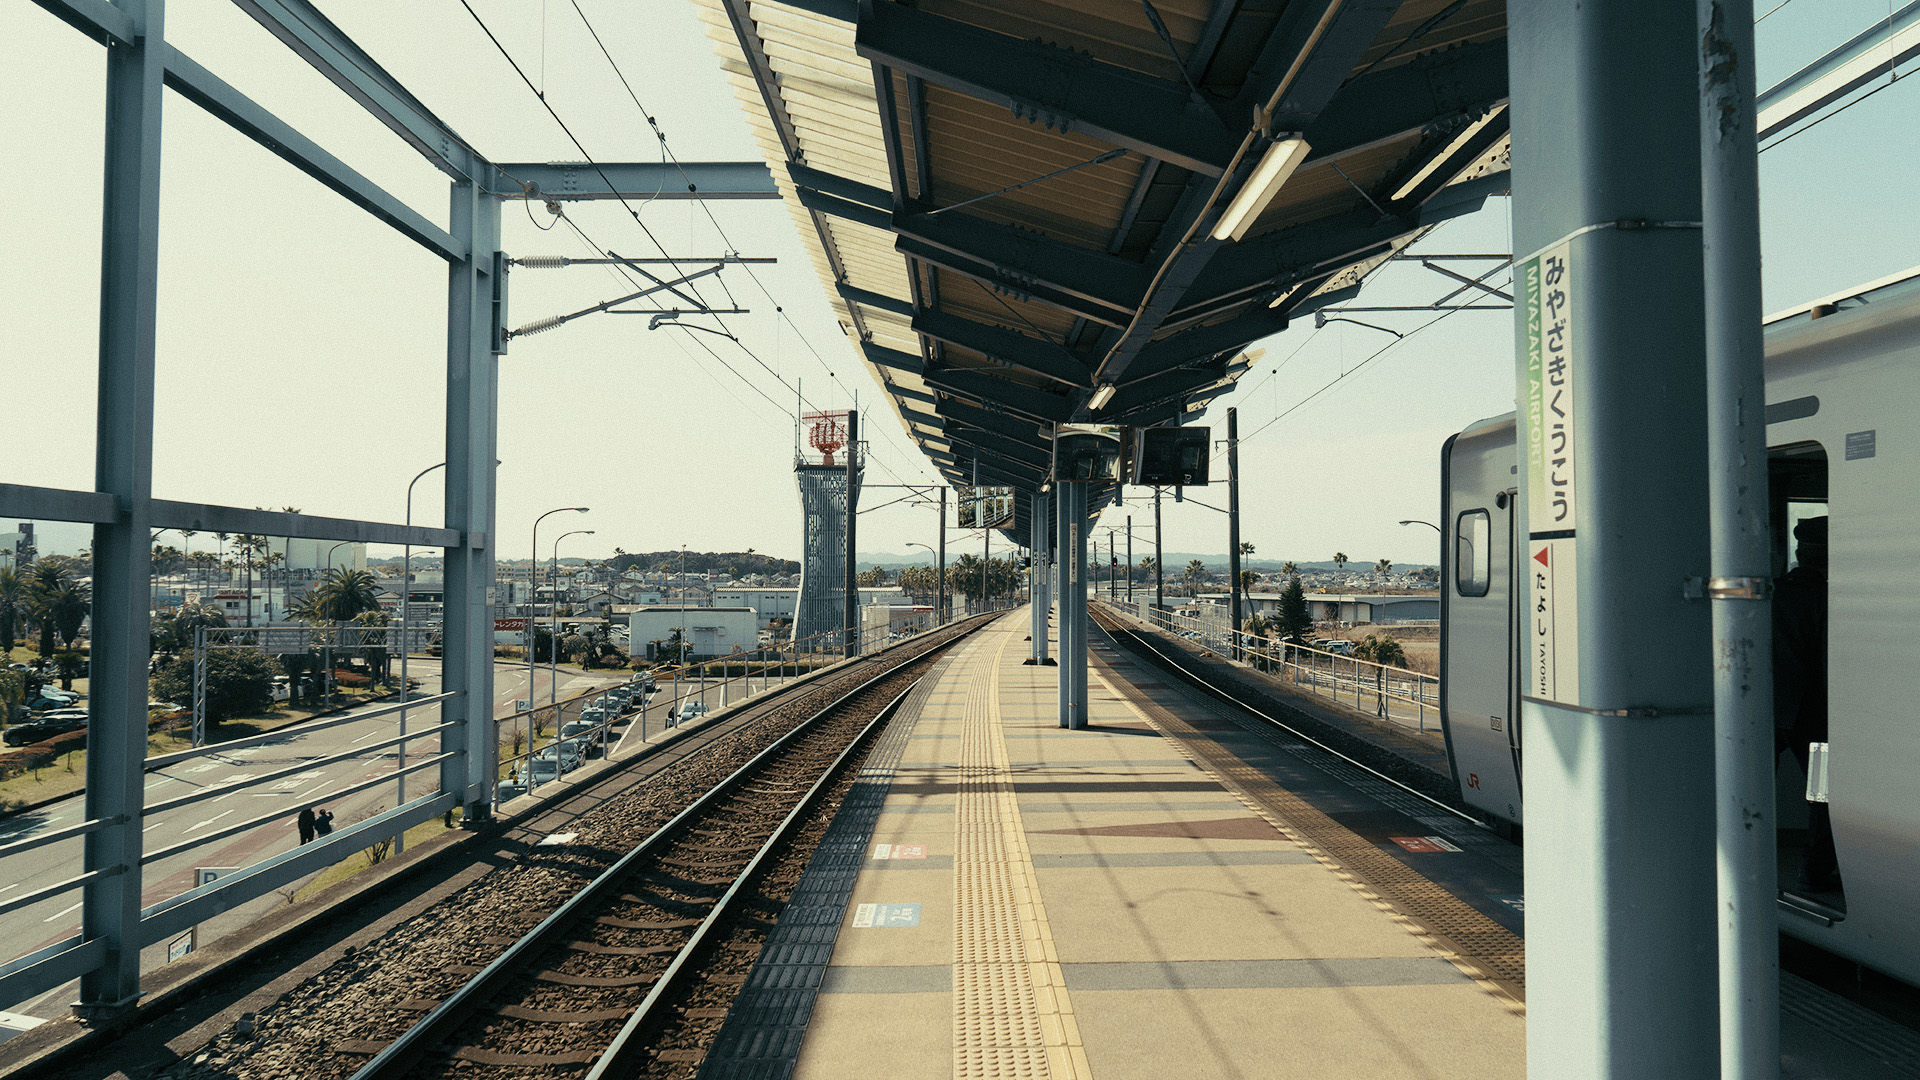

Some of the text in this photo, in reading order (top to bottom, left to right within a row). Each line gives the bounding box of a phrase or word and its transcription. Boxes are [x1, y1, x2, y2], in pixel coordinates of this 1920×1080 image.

[1527, 265, 1542, 467] MIYAZAKI AIRPORT
[1545, 256, 1568, 521] みやざきくうこう
[1536, 572, 1547, 695] たよし TAYOSHI
[1466, 772, 1481, 791] JR
